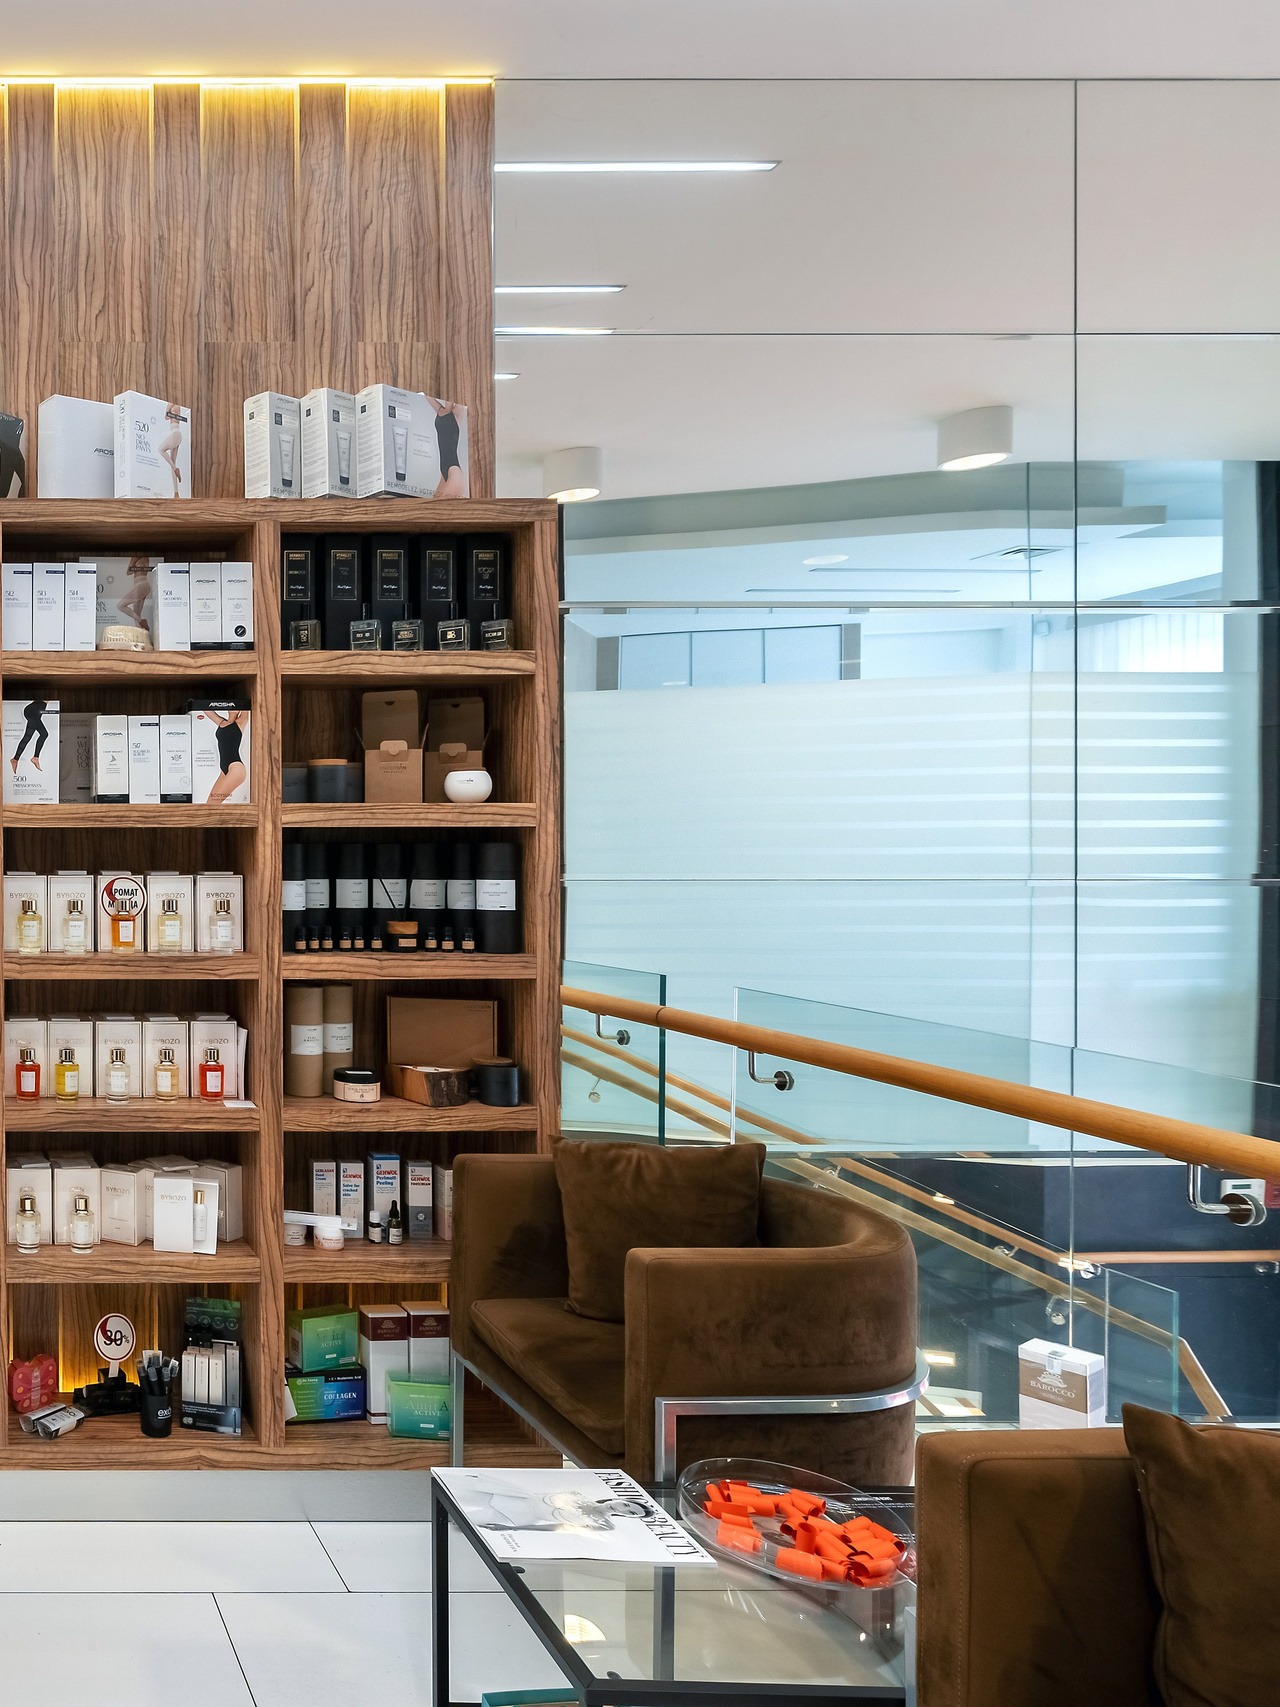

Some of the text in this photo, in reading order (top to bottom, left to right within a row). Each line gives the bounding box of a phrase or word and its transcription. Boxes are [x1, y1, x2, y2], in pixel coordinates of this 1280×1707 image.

[94, 447, 114, 455] AROS
[105, 1186, 130, 1195] BYBOZO
[1030, 1380, 1076, 1398] BAROCCO
[324, 1392, 357, 1400] COLLAGEN
